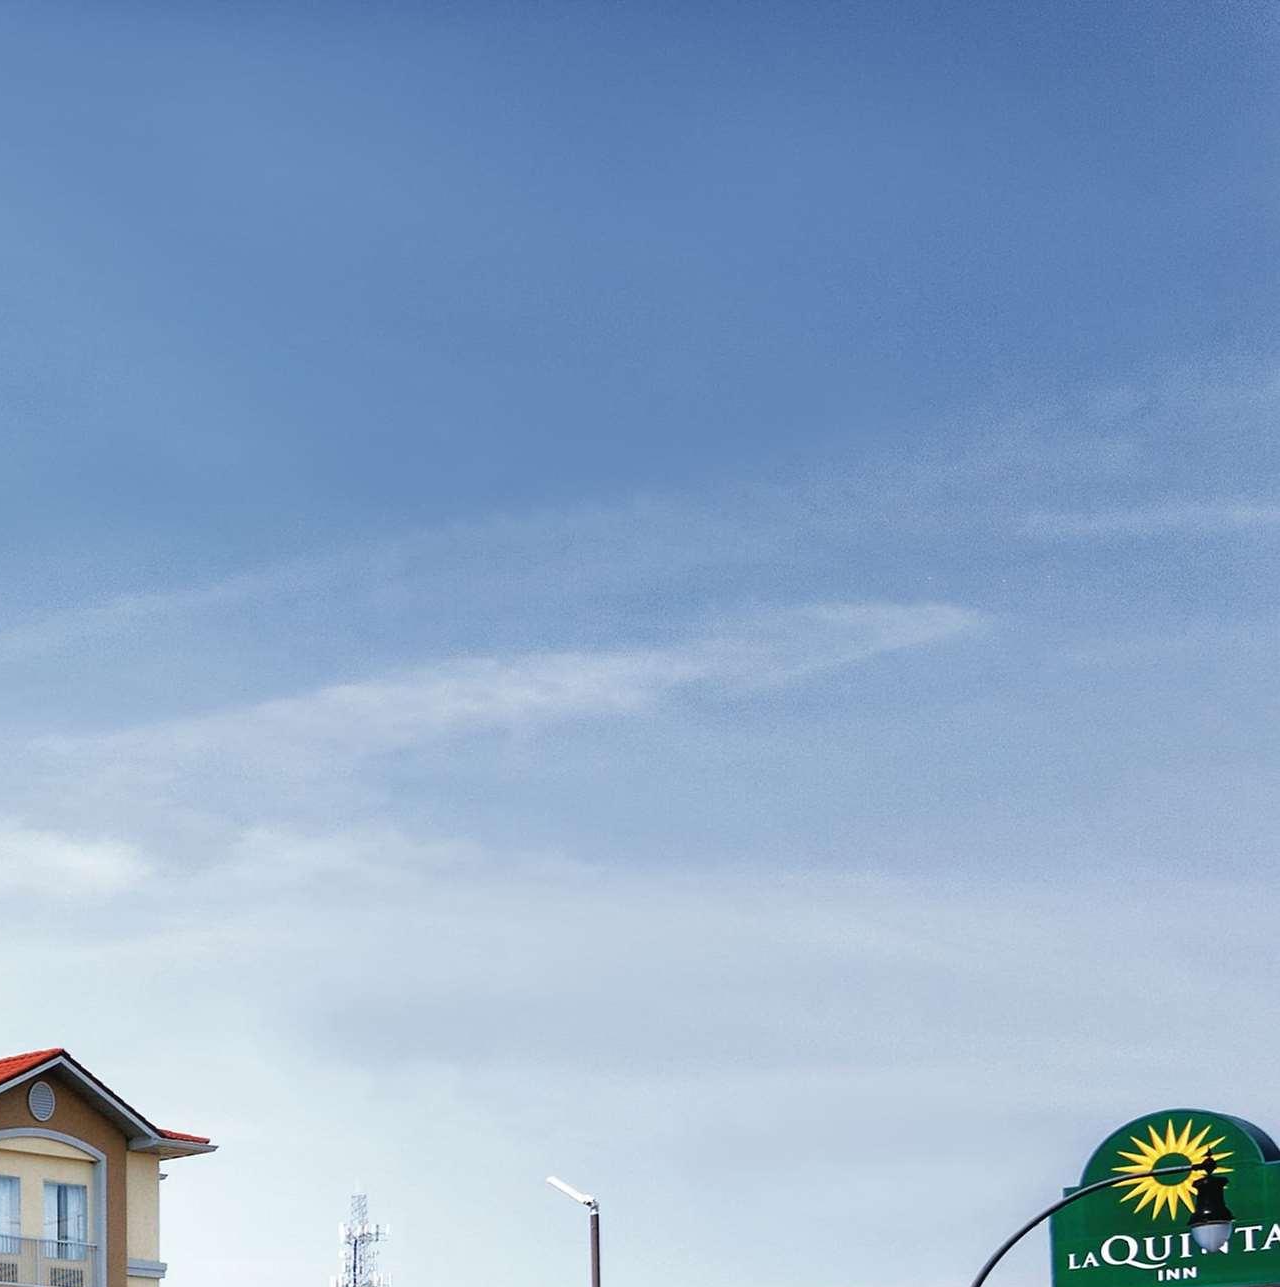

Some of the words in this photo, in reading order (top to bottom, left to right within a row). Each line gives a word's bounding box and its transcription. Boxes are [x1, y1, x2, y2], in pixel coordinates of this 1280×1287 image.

[1068, 1252, 1100, 1270] LA
[1101, 1223, 1280, 1270] QUITA
[1157, 1266, 1197, 1281] INN
